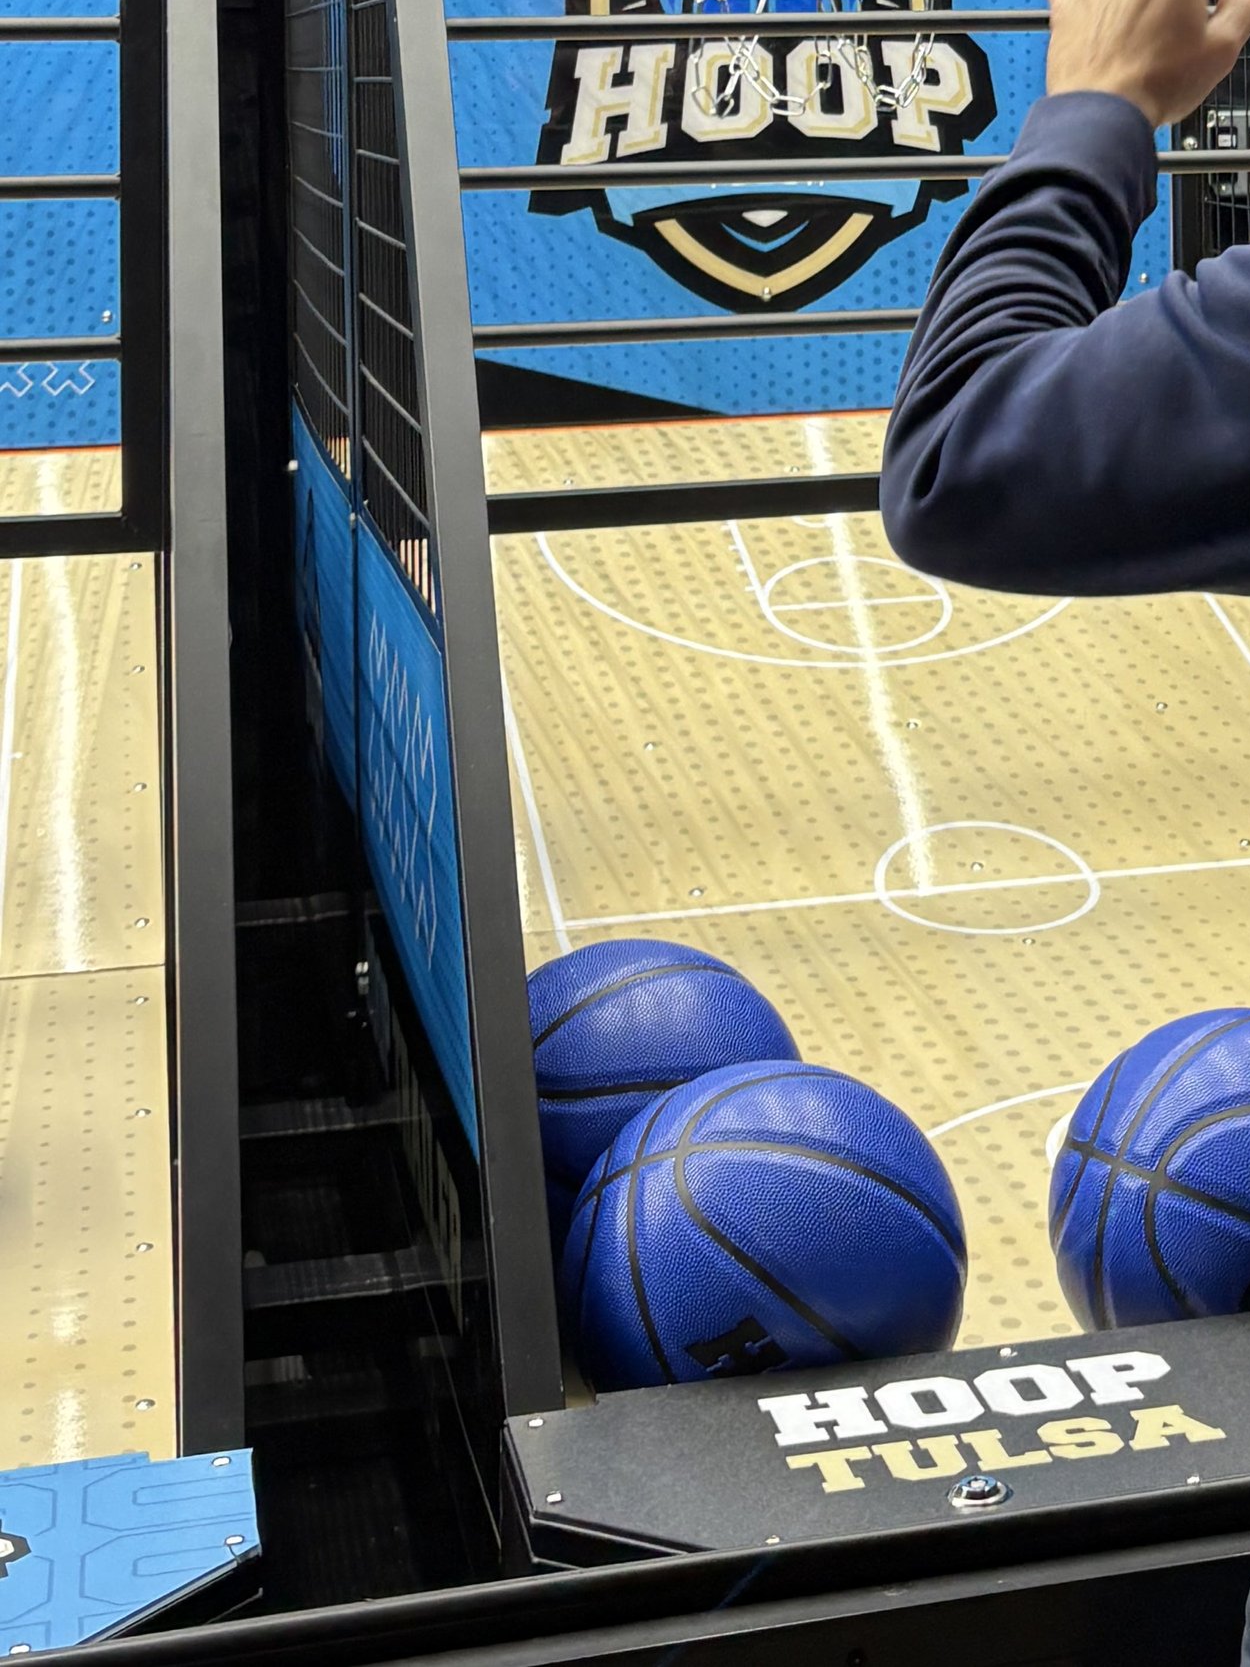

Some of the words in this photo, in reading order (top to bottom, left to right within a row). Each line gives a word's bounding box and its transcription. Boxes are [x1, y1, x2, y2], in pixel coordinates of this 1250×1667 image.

[560, 39, 973, 166] HOOP
[757, 1350, 1172, 1447] HOOP
[785, 1404, 1227, 1494] TULSA
